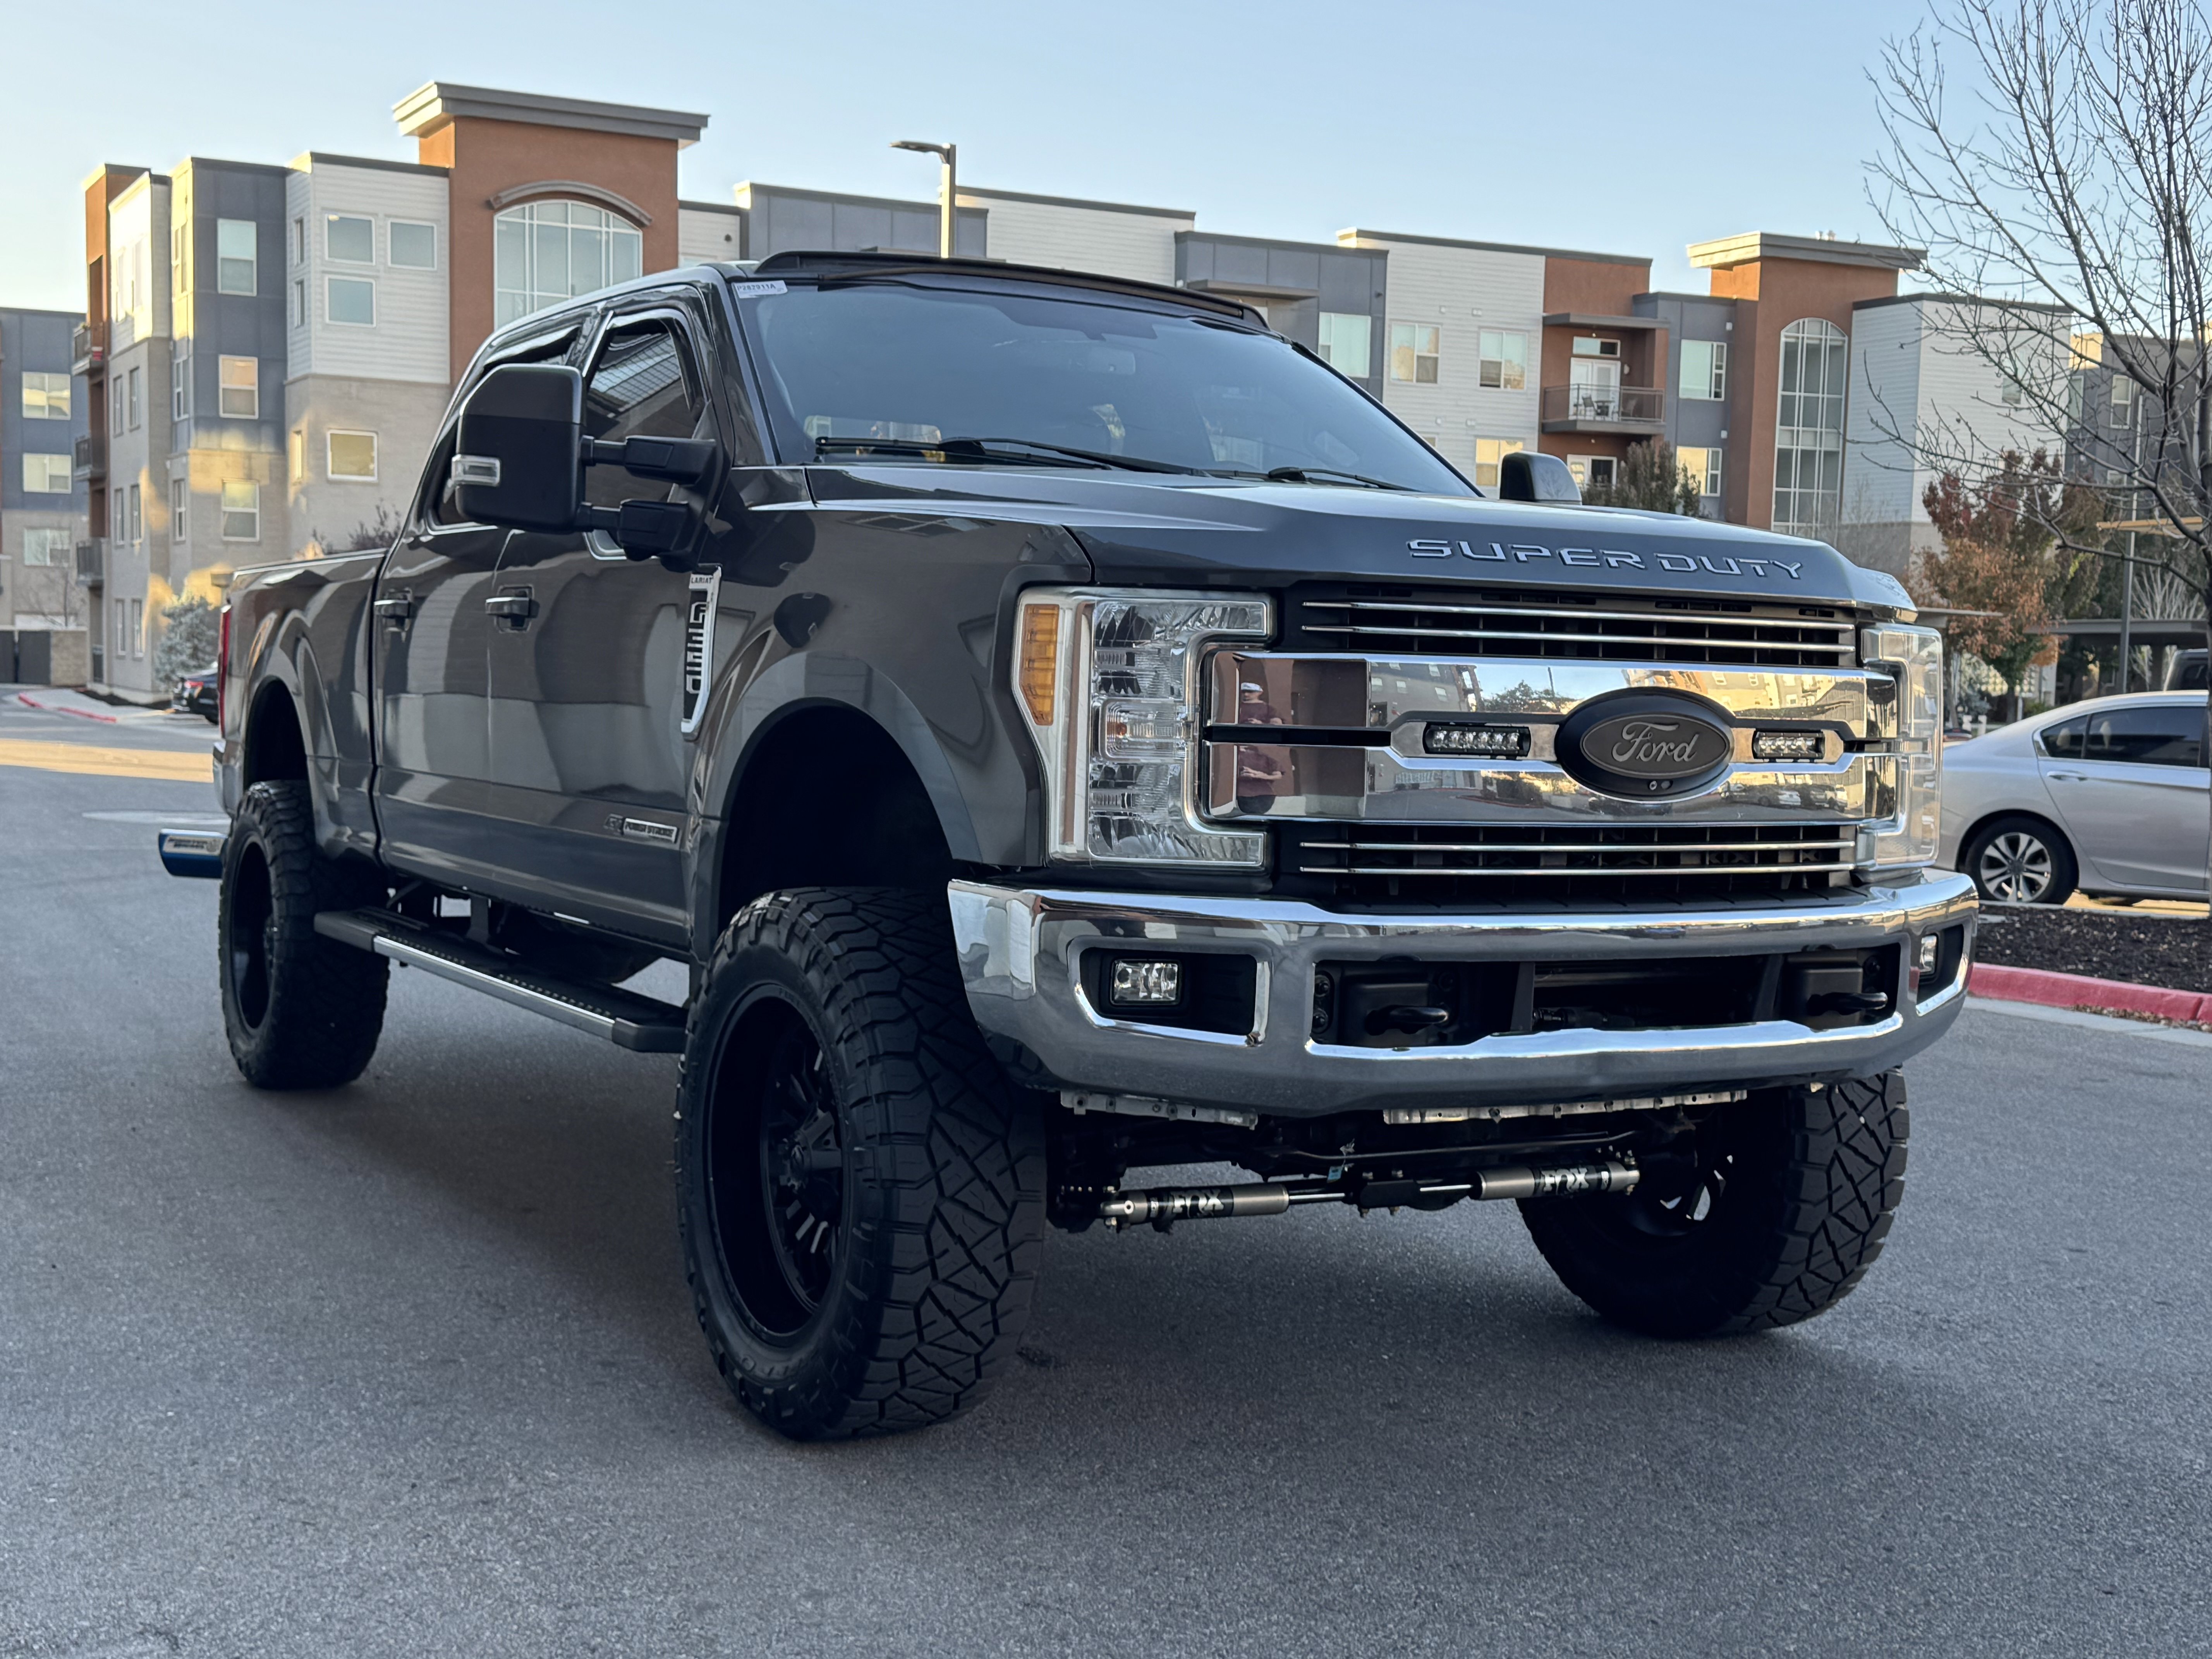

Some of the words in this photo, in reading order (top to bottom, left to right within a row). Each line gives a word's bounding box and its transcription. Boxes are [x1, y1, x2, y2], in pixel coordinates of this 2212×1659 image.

[1407, 538, 1645, 569] SUPER
[1653, 551, 1803, 579] DUTY
[1612, 721, 1700, 762] Ford
[1541, 1167, 1589, 1194] FOX
[1170, 1188, 1224, 1217] FOX
